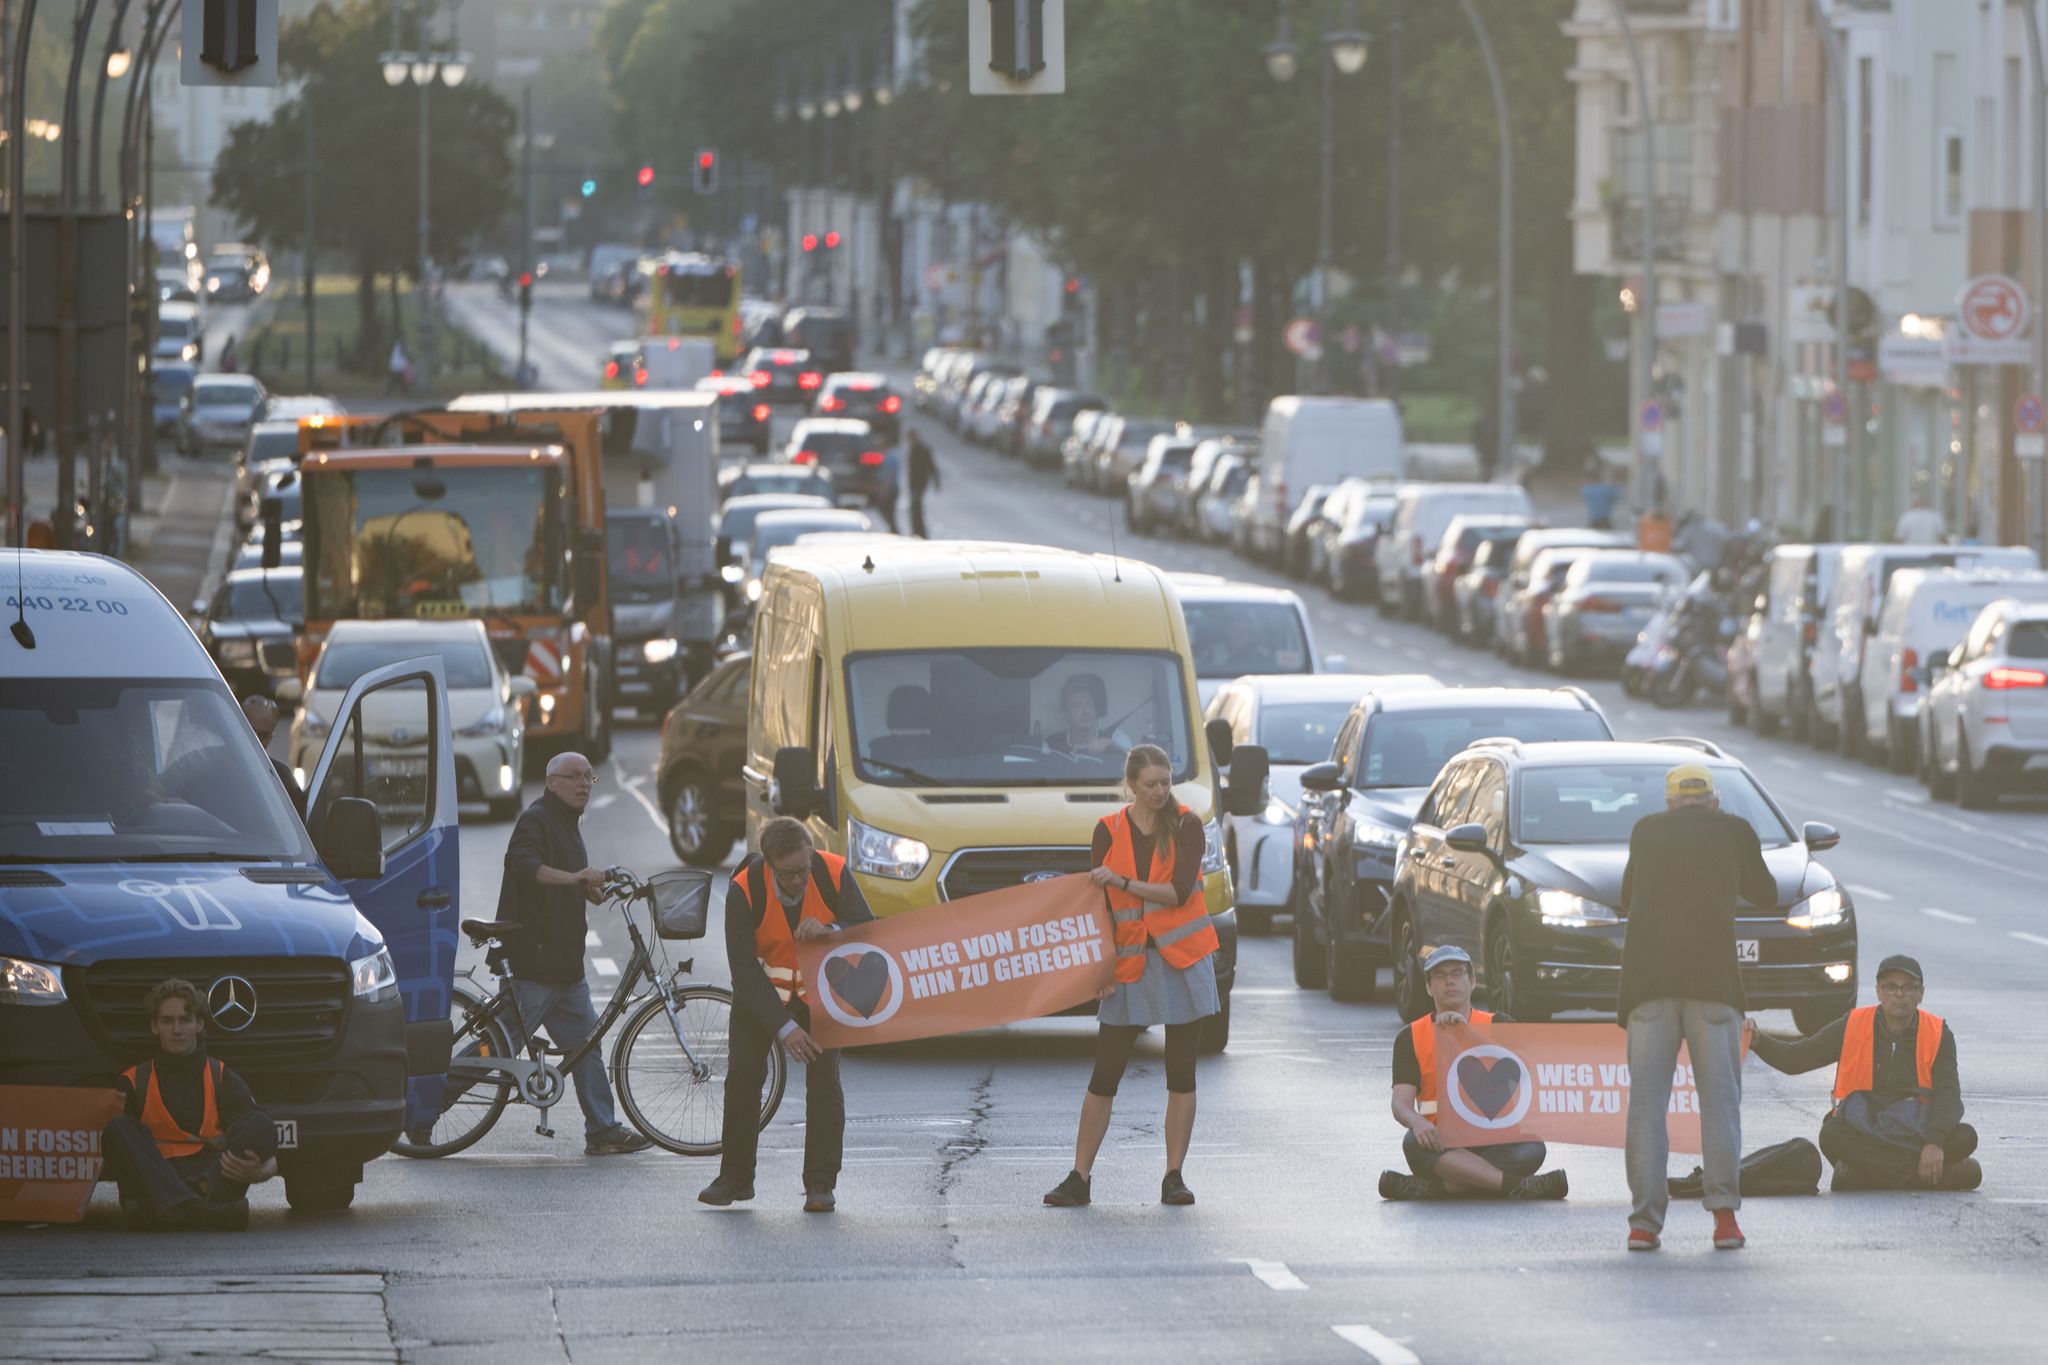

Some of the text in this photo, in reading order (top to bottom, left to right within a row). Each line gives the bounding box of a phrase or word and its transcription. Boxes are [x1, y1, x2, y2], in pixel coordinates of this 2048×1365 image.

[6, 596, 129, 616] 440 22 00
[901, 912, 1100, 973] WEG VON FOSSIL
[908, 938, 1103, 1000] HIN ZU GERECHT
[1536, 1063, 1632, 1088] WEG VO
[1539, 1089, 1621, 1114] HIN ZU
[25, 1128, 102, 1153] FOSSI
